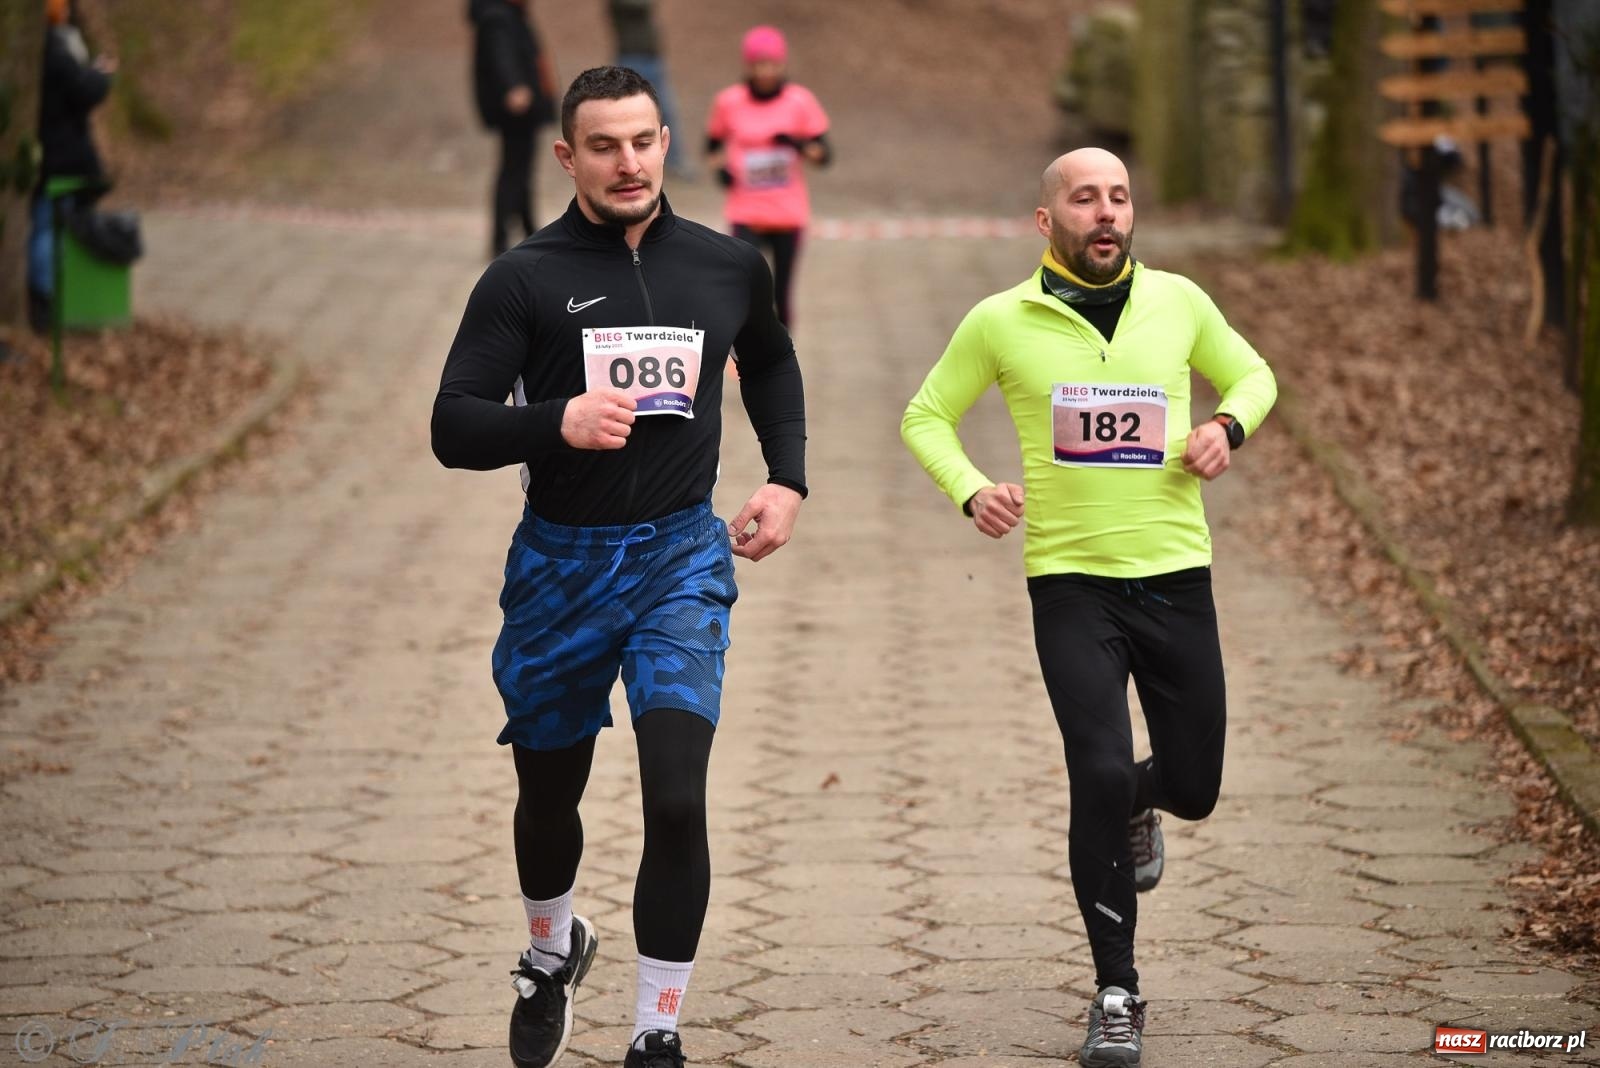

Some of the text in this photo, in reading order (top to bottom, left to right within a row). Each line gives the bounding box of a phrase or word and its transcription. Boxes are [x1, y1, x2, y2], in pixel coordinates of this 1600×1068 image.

[594, 331, 694, 343] BIEG Twardziela
[609, 356, 686, 390] 086
[1062, 386, 1158, 398] BIEG Twardziela
[1079, 411, 1141, 443] 182
